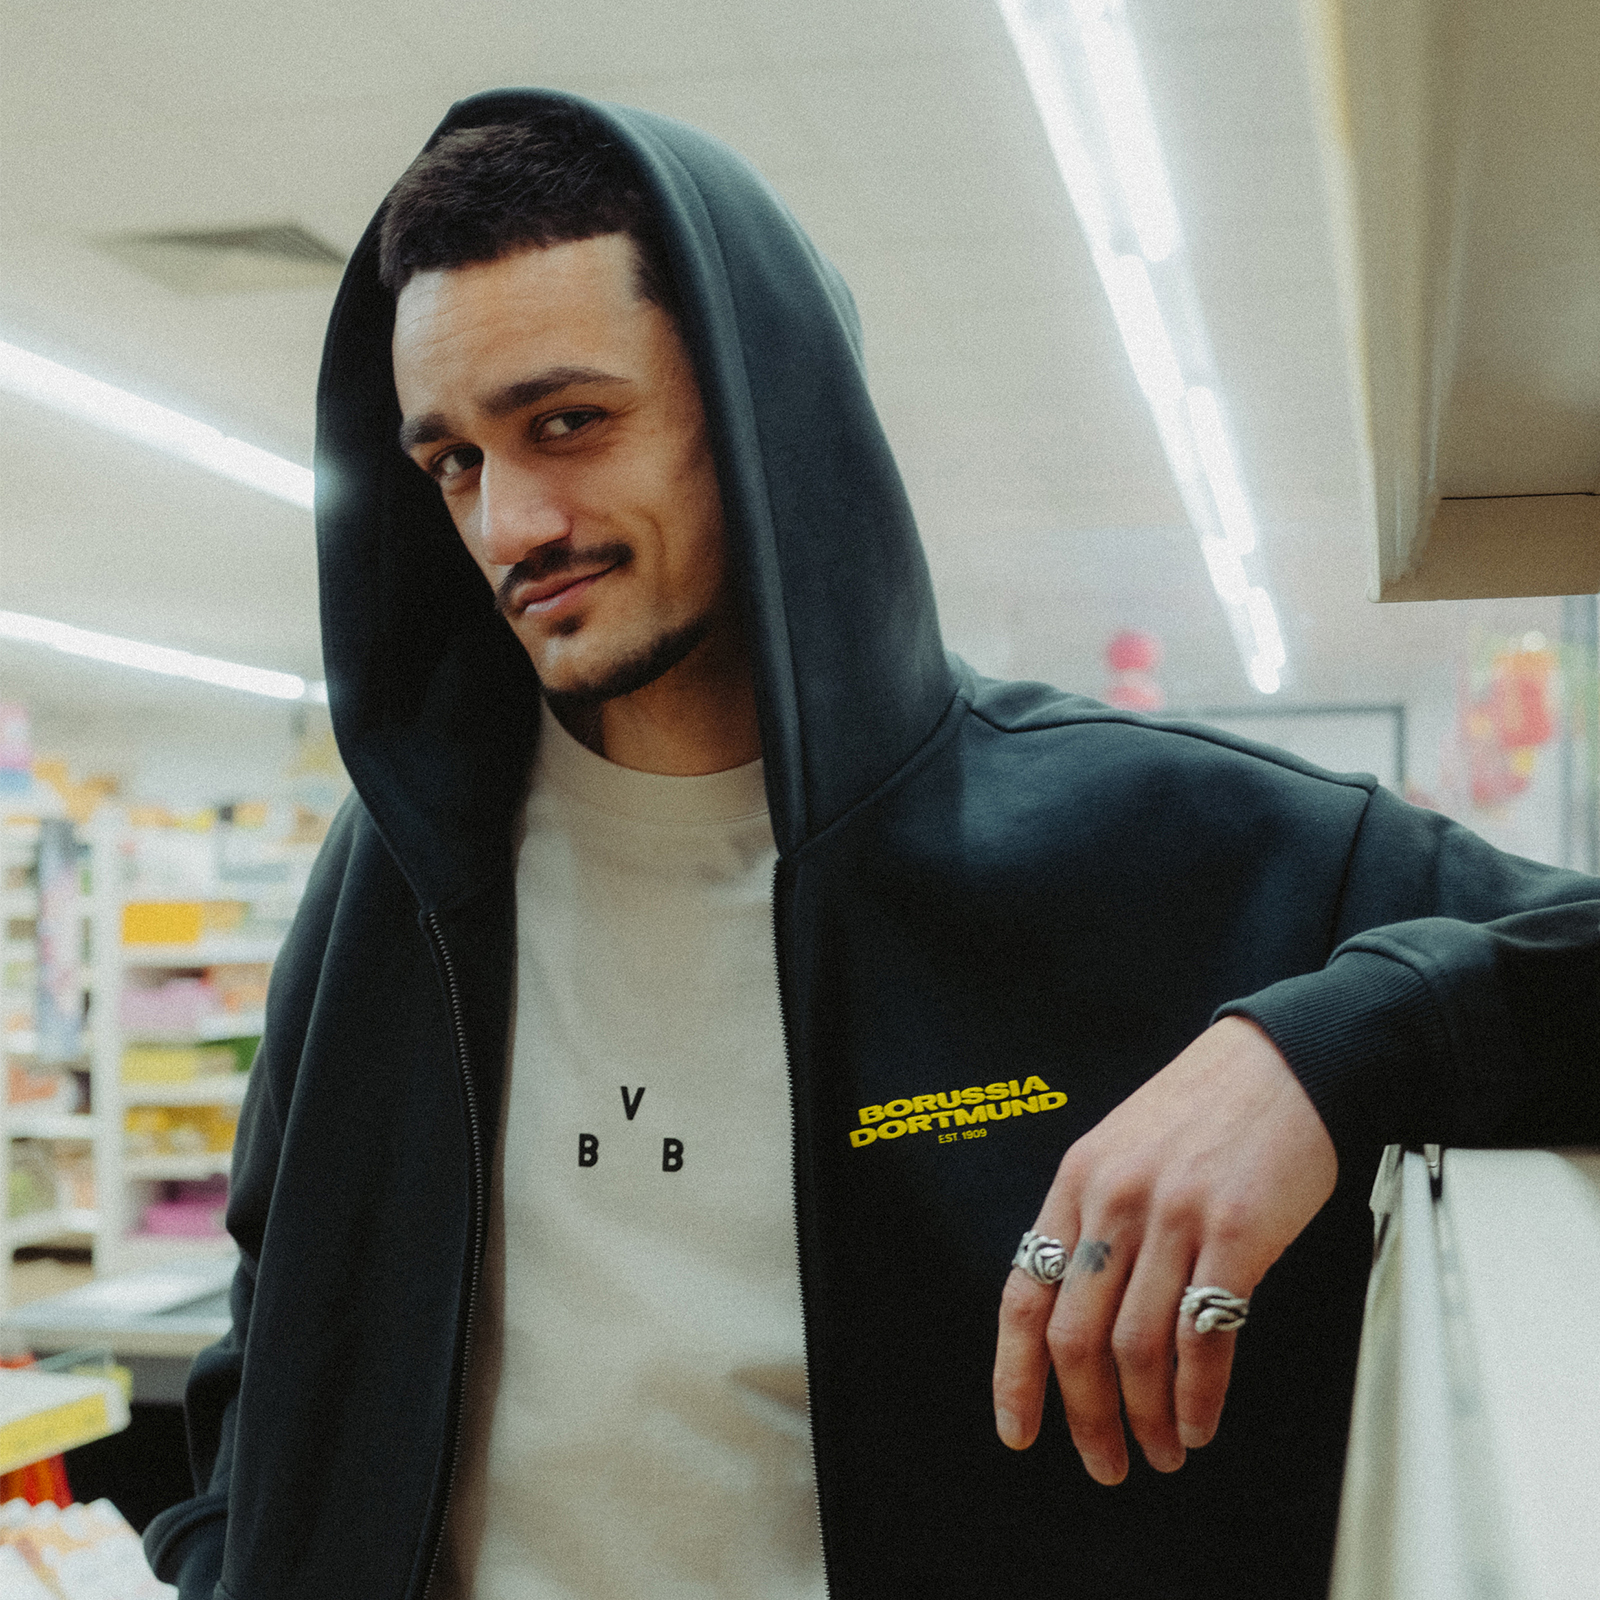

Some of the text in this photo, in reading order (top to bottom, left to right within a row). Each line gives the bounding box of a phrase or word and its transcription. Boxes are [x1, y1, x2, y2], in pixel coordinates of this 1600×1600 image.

[620, 1085, 646, 1121] V
[849, 1091, 1068, 1148] DORTMUND
[858, 1075, 1050, 1126] BORUSSIA
[578, 1133, 685, 1173] B B
[961, 1128, 988, 1140] 1909
